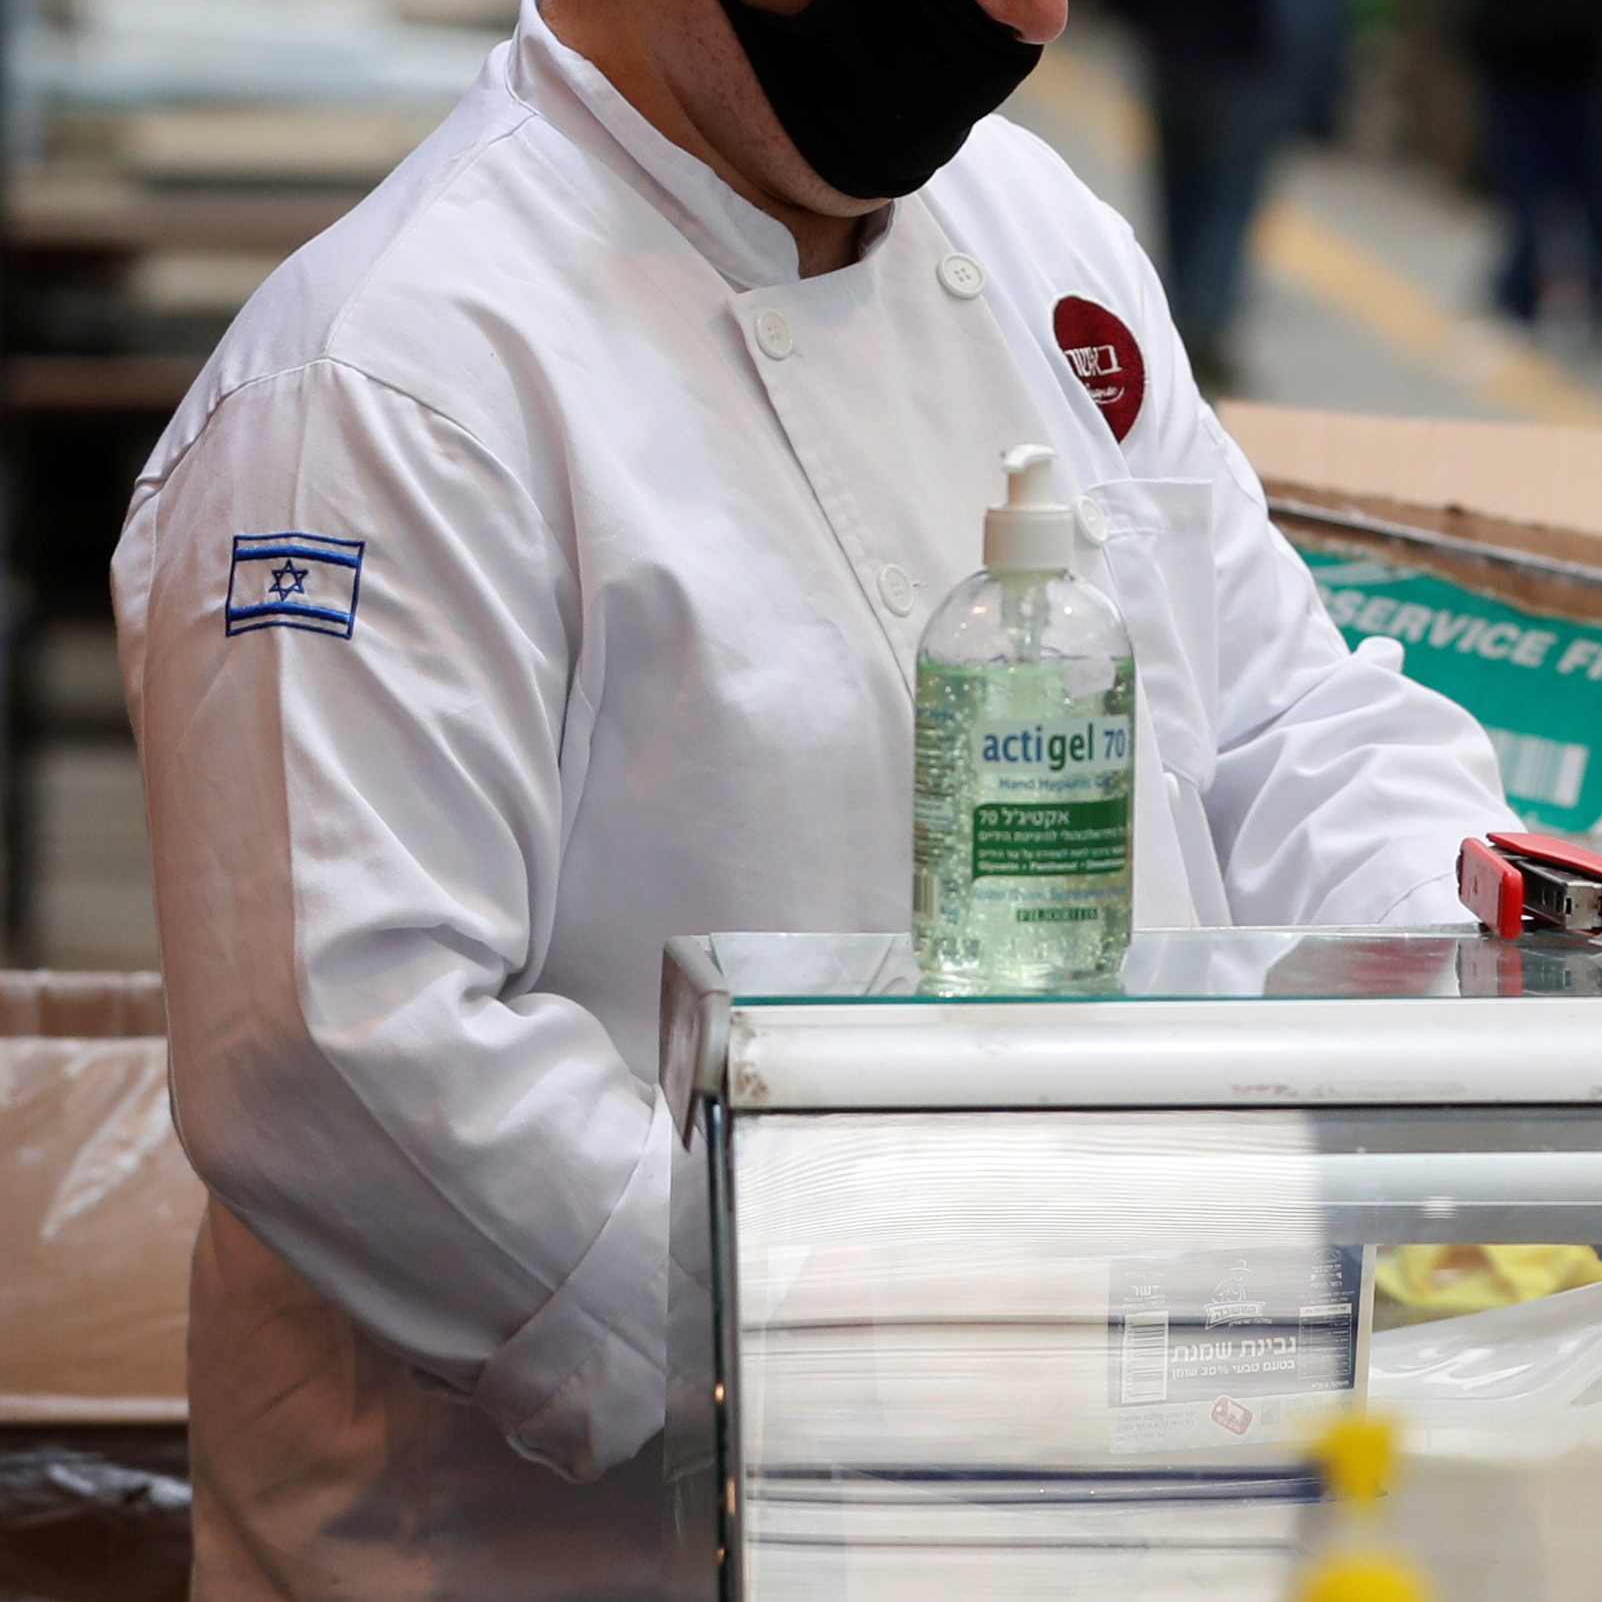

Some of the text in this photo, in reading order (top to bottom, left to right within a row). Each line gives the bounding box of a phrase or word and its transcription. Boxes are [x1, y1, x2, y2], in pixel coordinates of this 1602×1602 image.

[983, 724, 1126, 771] actigel 70
[979, 809, 999, 825] 70
[1170, 1335, 1297, 1364] גבינת שמנת
[1231, 1362, 1260, 1375] טבעי
[1262, 1359, 1296, 1372] בטעם
[1171, 1367, 1198, 1380] שומן
